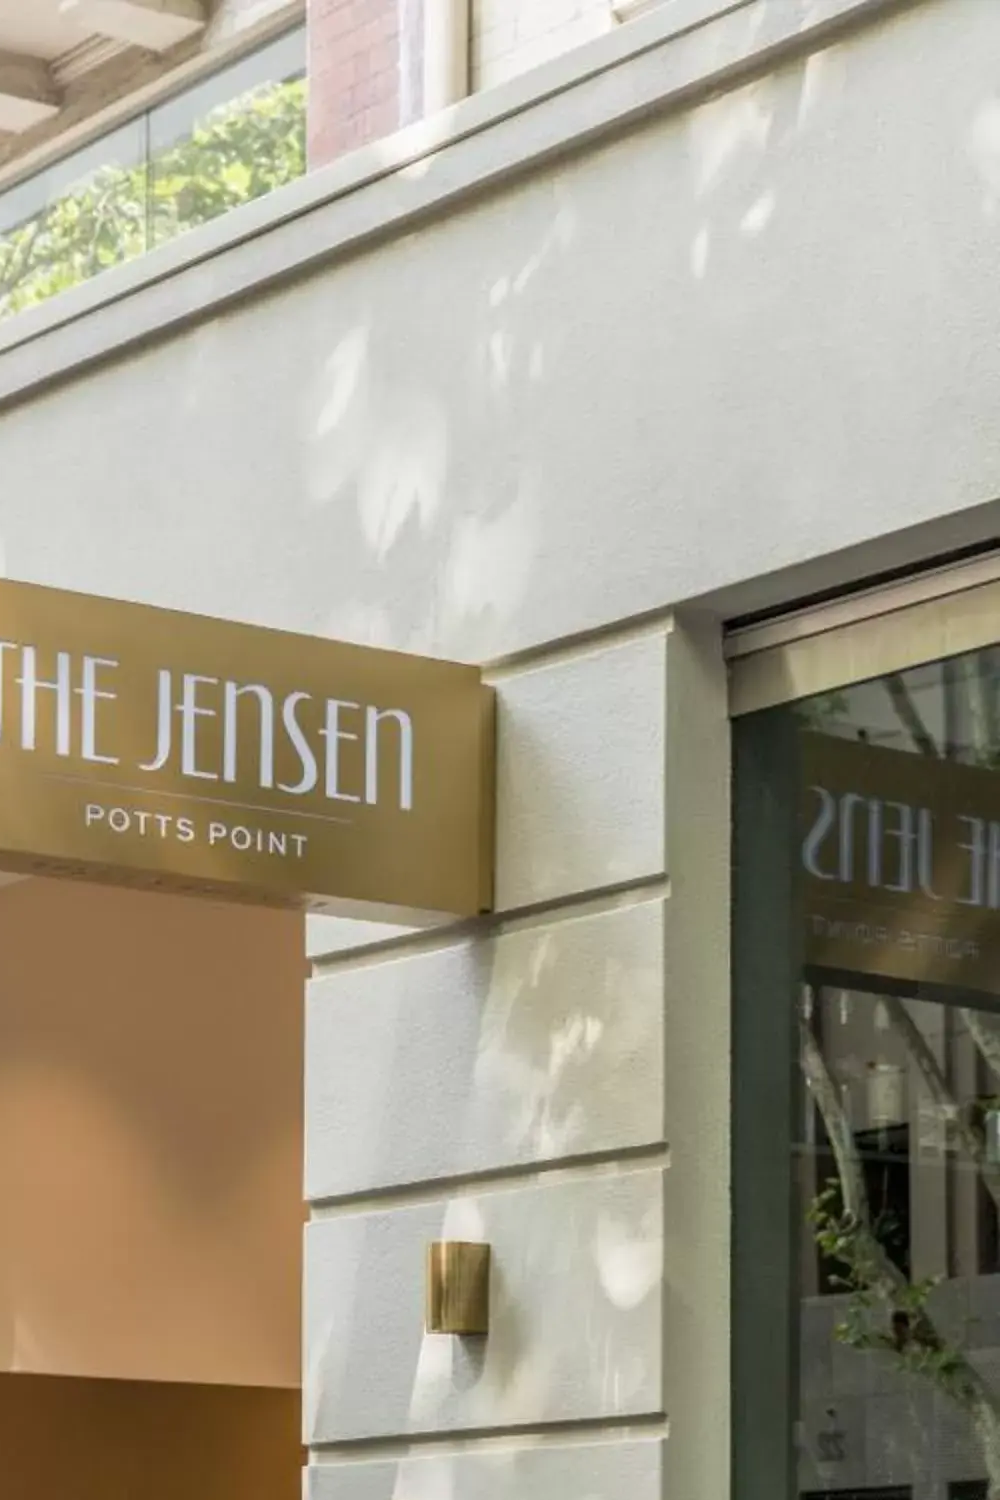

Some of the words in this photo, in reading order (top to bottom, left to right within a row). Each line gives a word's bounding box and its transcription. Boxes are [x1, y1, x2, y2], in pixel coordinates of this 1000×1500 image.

[138, 669, 412, 810] JENSEN
[84, 803, 195, 842] POTTS
[208, 822, 307, 857] POINT
